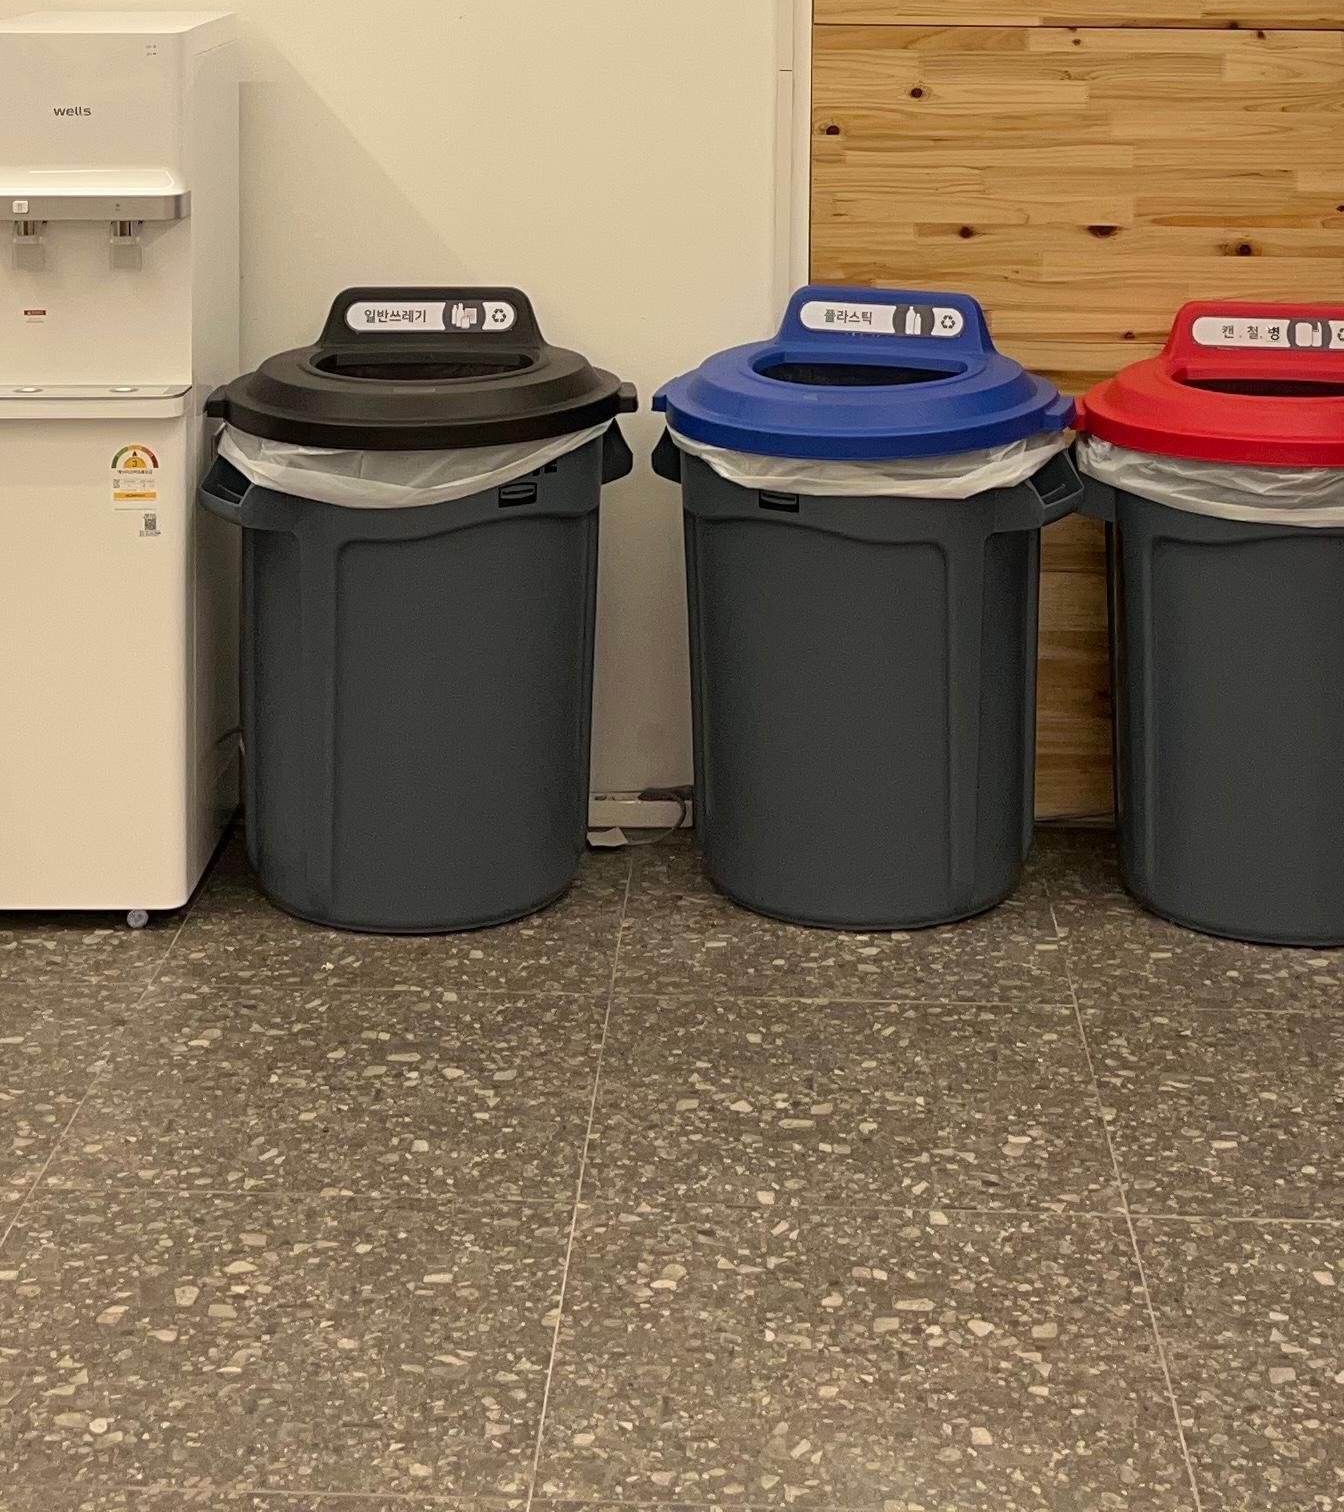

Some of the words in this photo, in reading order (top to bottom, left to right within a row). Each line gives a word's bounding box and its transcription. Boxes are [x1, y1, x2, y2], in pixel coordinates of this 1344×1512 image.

[53, 106, 92, 117] wells
[364, 309, 427, 324] 일반쓰레기
[824, 309, 873, 325] 플라스틱
